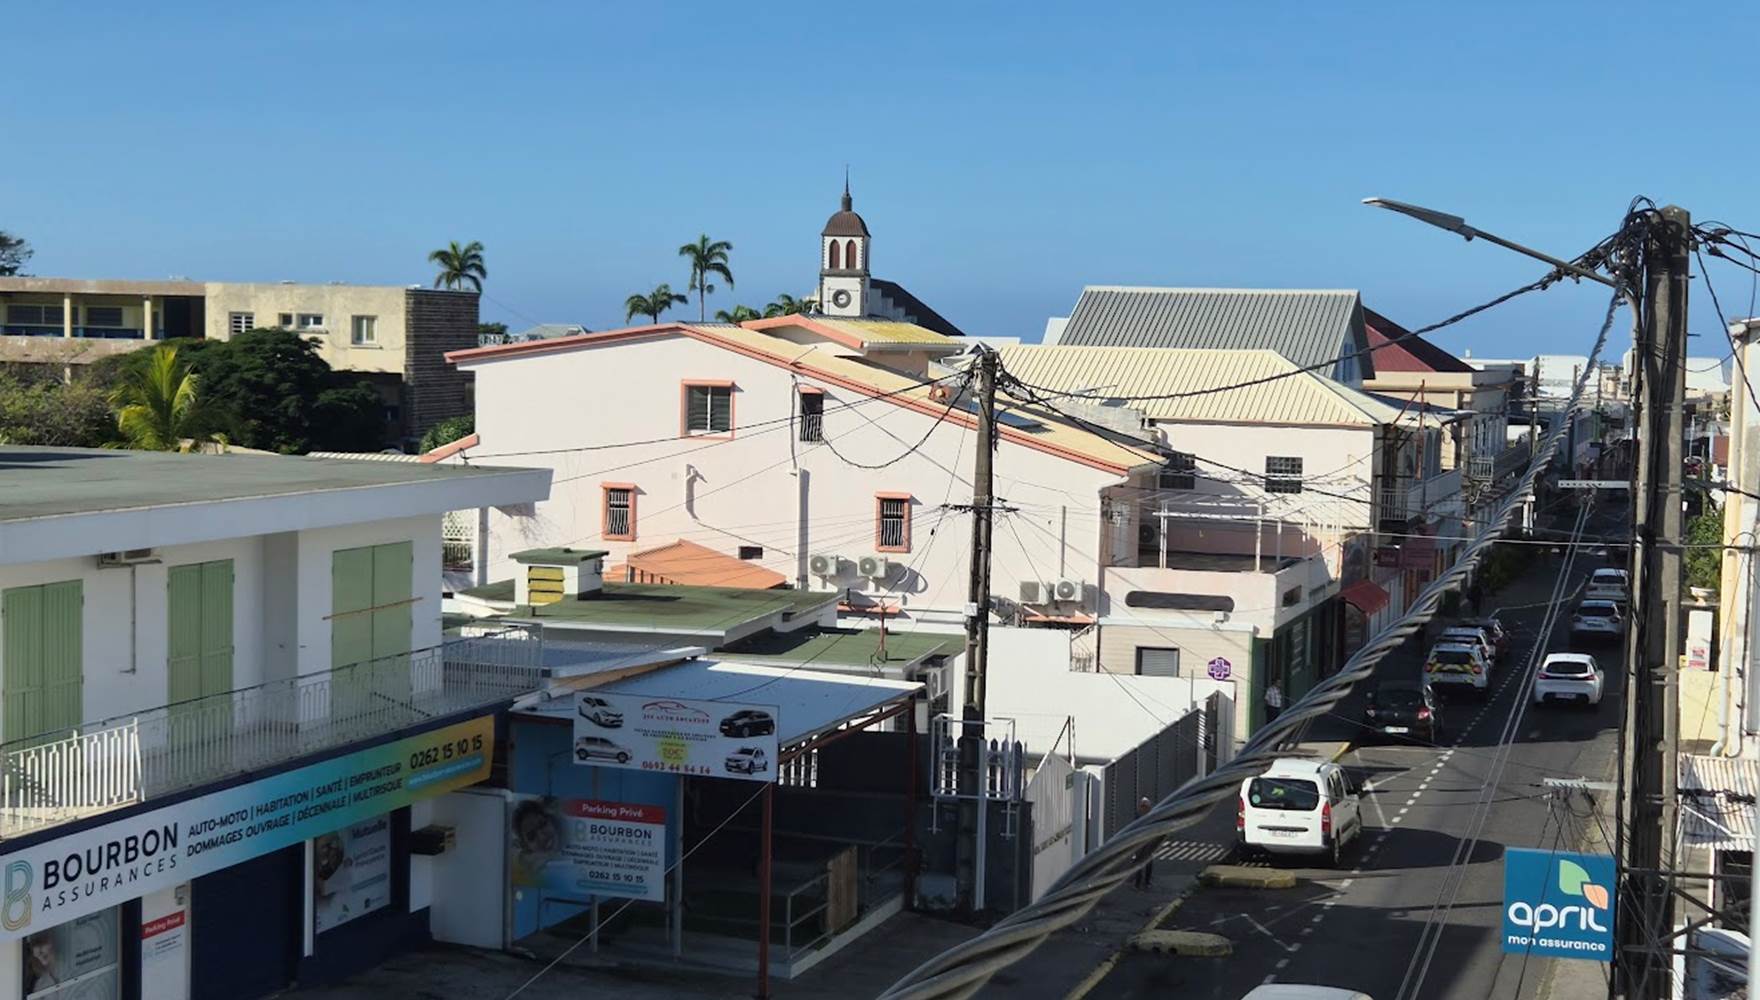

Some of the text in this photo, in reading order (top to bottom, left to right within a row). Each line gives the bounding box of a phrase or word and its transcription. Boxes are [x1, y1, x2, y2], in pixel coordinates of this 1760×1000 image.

[410, 734, 483, 769] 0262 15 10 15
[187, 809, 249, 838] AUTO-MOTO
[255, 789, 310, 816] HABITATION
[315, 778, 343, 798] SANTÉ
[350, 762, 402, 788] EMPRUNTEUR
[582, 803, 644, 818] Parking Privé
[186, 777, 403, 858] DOMMAGES OUVRAGE DÉCENNALE MULTIRISQUE
[590, 824, 652, 839] BOURBON
[43, 822, 179, 890] BOURBON
[42, 853, 178, 912] ASSURANCES
[588, 870, 645, 884] 0262 15 10 15
[1508, 901, 1608, 934] april
[1508, 935, 1606, 952] mon assurance
